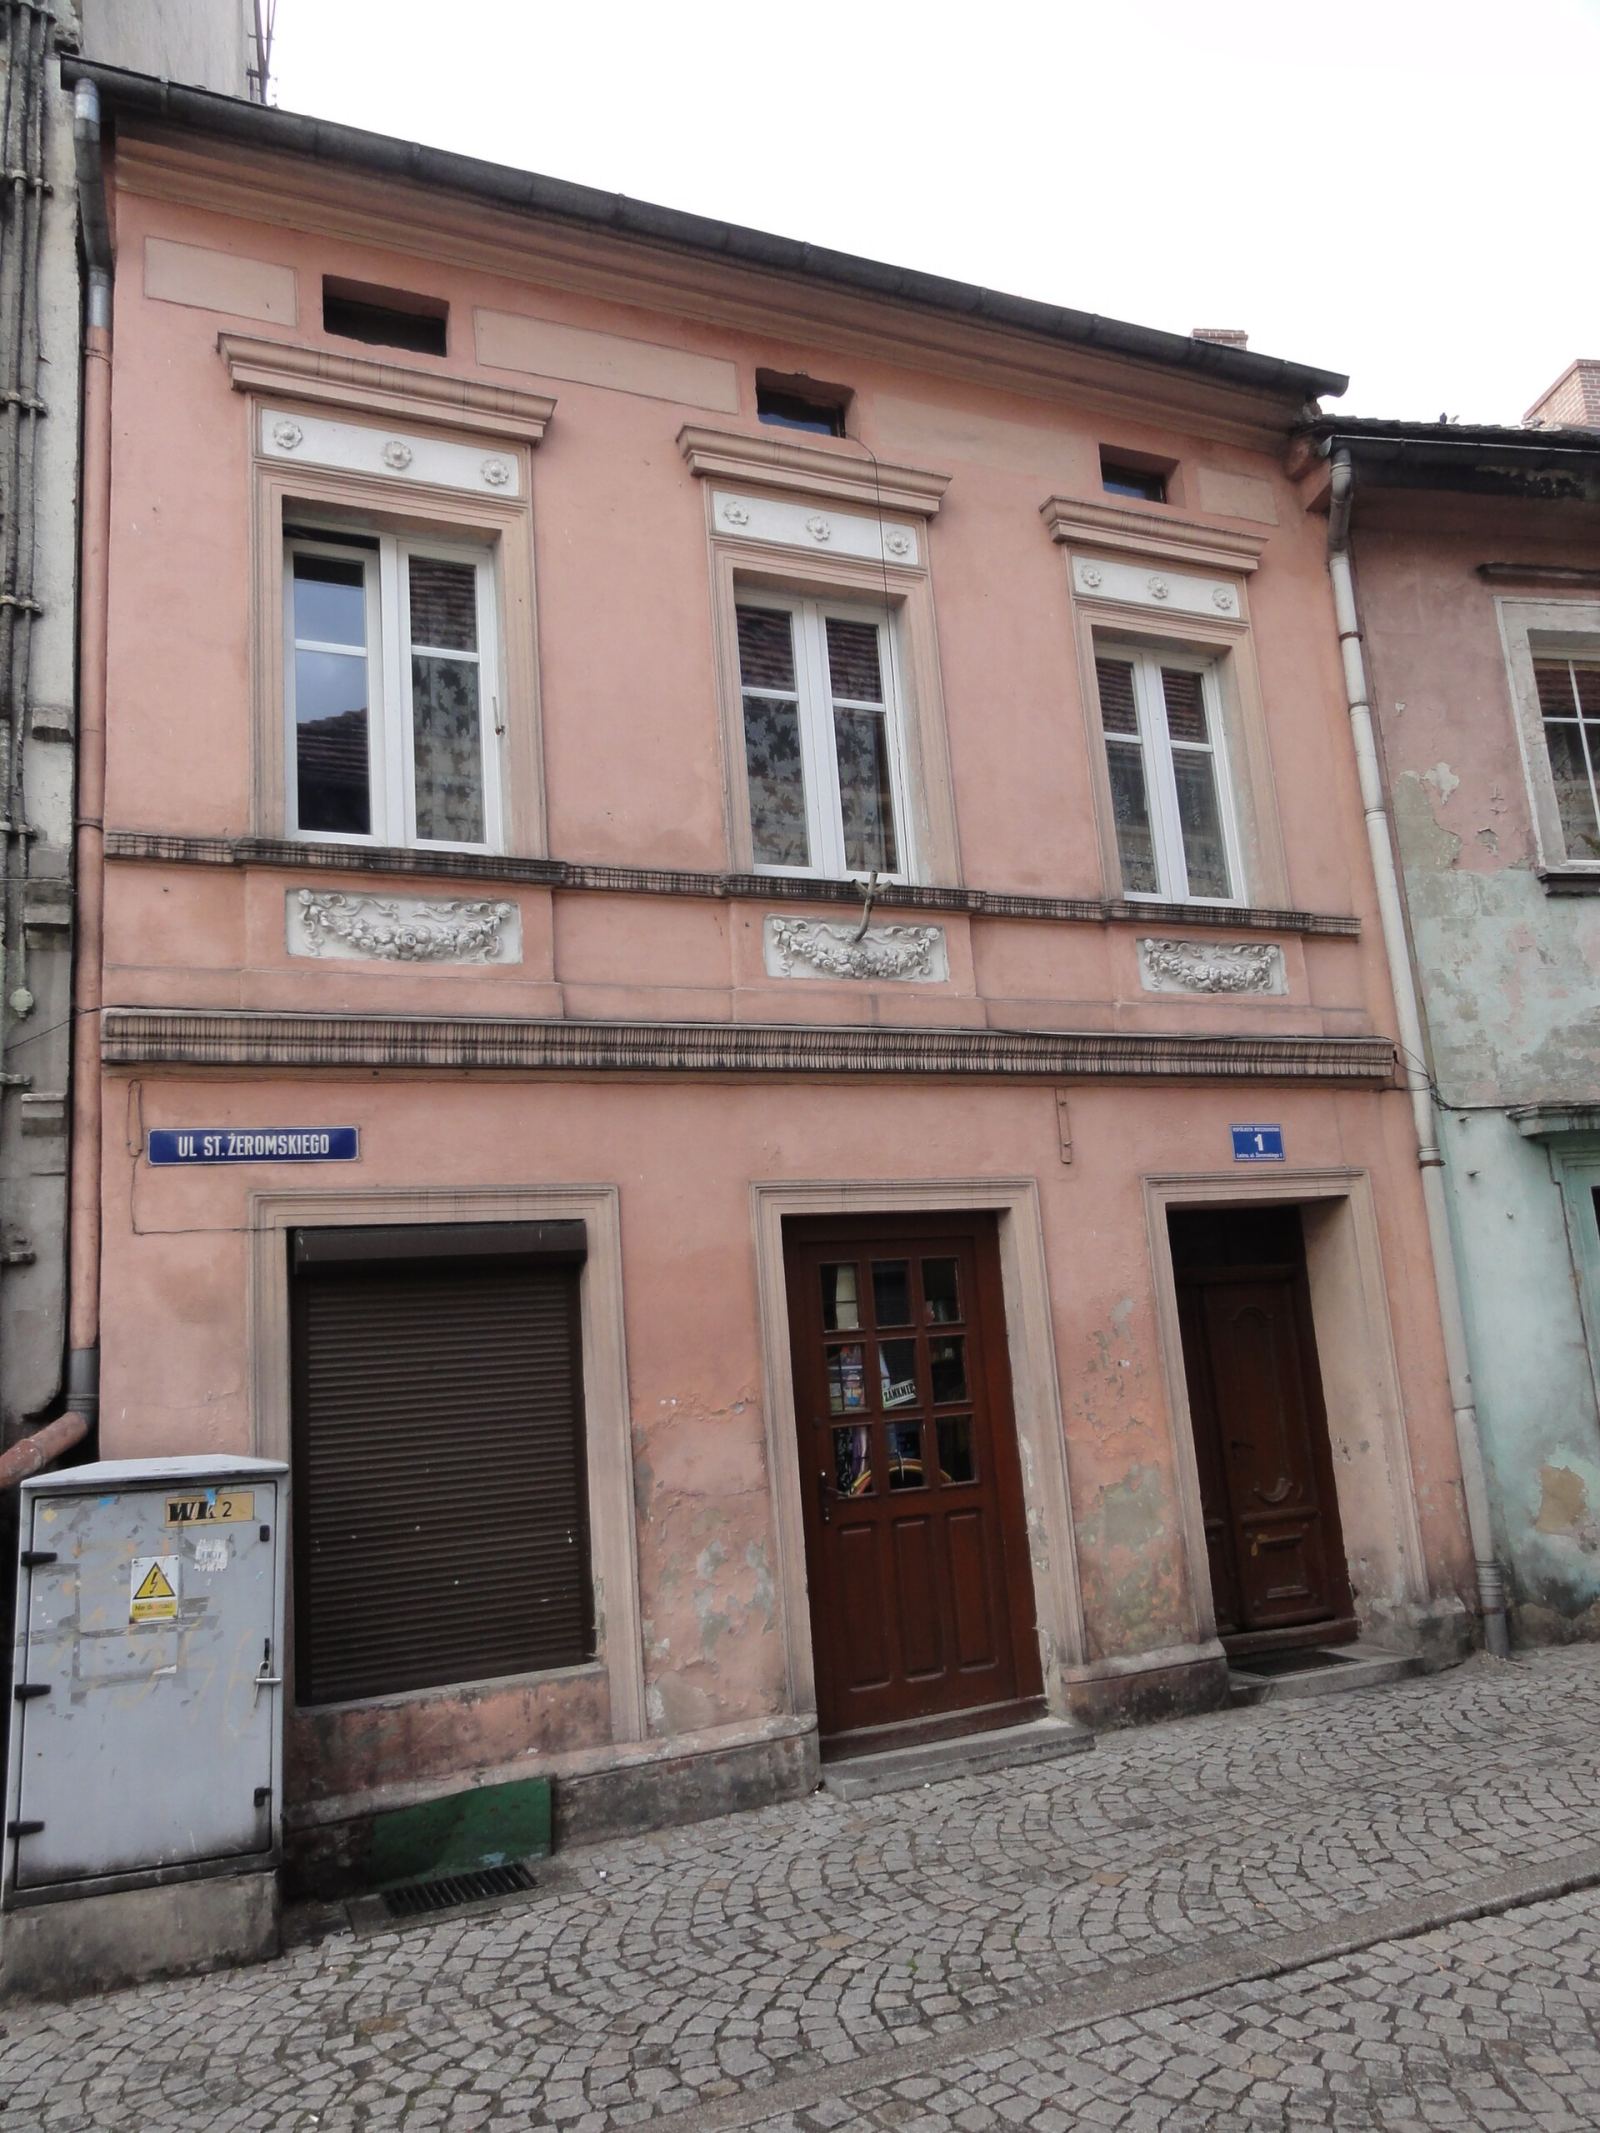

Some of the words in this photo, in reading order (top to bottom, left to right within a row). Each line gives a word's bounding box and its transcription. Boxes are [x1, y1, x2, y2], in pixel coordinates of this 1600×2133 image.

[178, 1136, 197, 1157] UL
[203, 1135, 226, 1157] ST.
[227, 1132, 330, 1157] ŻEROMSKIEGO
[1254, 1133, 1264, 1151] 1
[222, 1501, 232, 1518] 2
